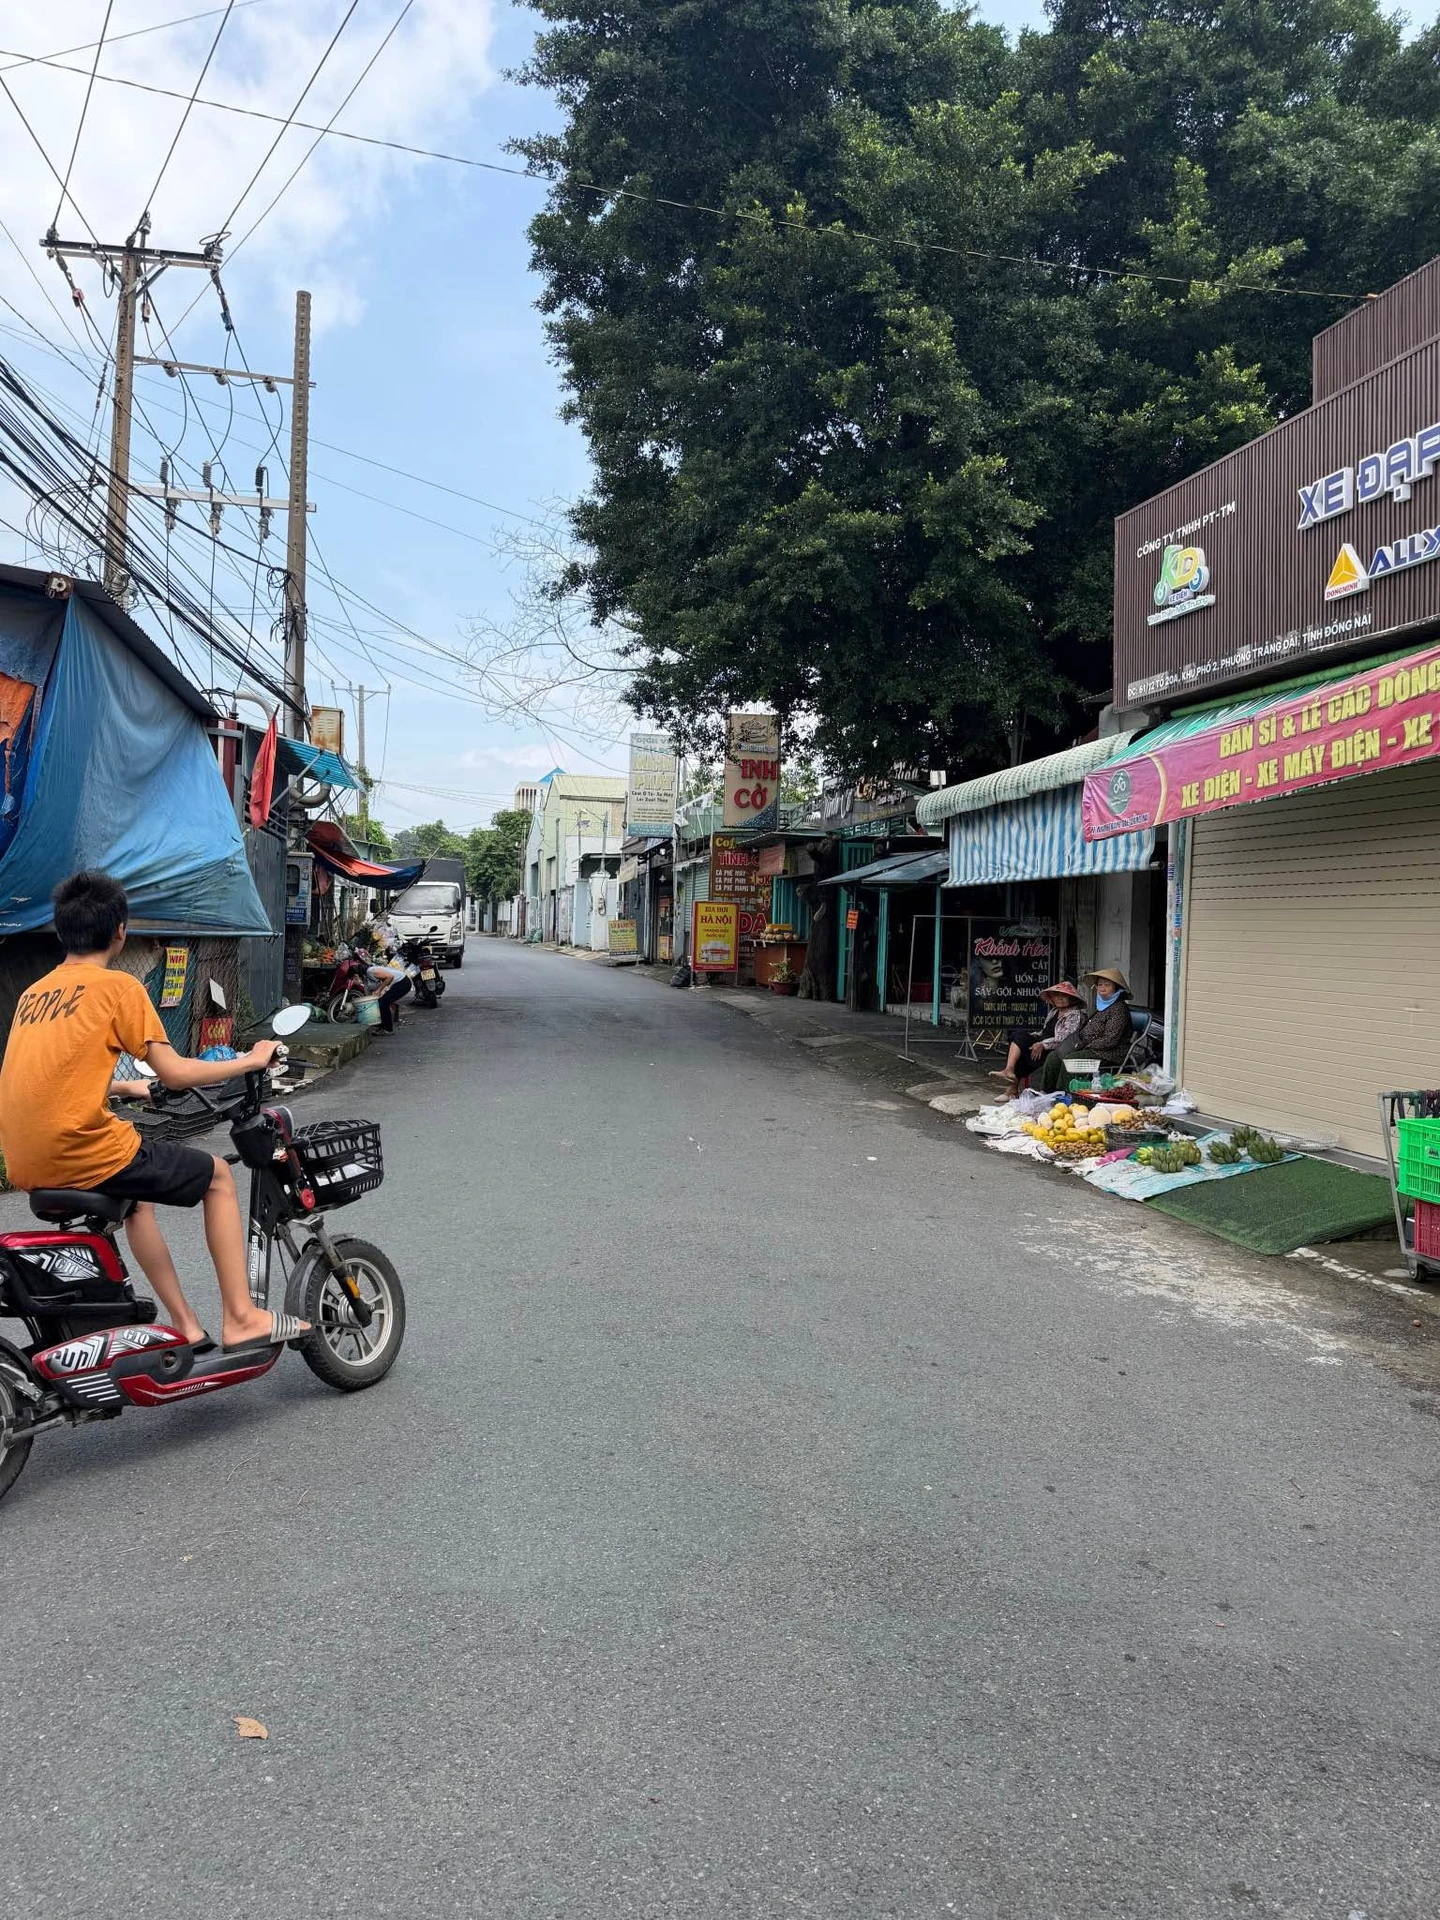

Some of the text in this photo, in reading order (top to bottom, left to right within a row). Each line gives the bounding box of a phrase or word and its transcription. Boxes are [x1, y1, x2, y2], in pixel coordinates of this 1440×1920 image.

[1298, 467, 1353, 529] XE
[1136, 501, 1236, 558] CÔNG TY TNHH PT-TM
[1182, 669, 1196, 681] KHU
[1196, 659, 1212, 677] PHỐ
[1302, 628, 1323, 644] TỈNH
[1324, 619, 1353, 637] ĐỒNG
[1354, 613, 1371, 629] NAI
[1219, 723, 1254, 759] BÁN
[1259, 710, 1277, 747] SỈ
[1282, 714, 1297, 740] &
[1301, 696, 1322, 734] LẺ
[1327, 684, 1372, 725] CÁC
[1181, 782, 1200, 810] XE
[1203, 769, 1241, 803] ĐIỆN
[1257, 758, 1278, 789] XE
[1283, 744, 1327, 783] MÁY
[1331, 728, 1381, 770] ĐIỆN
[1403, 713, 1433, 750] XE
[734, 782, 768, 810] CỜ
[718, 850, 748, 866] TÌNH
[700, 913, 732, 926] HÀ NỘI
[169, 954, 185, 964] WIFI
[974, 937, 1020, 956] Khánh
[12, 985, 86, 1029] PEOPLE
[123, 1329, 150, 1346] G10
